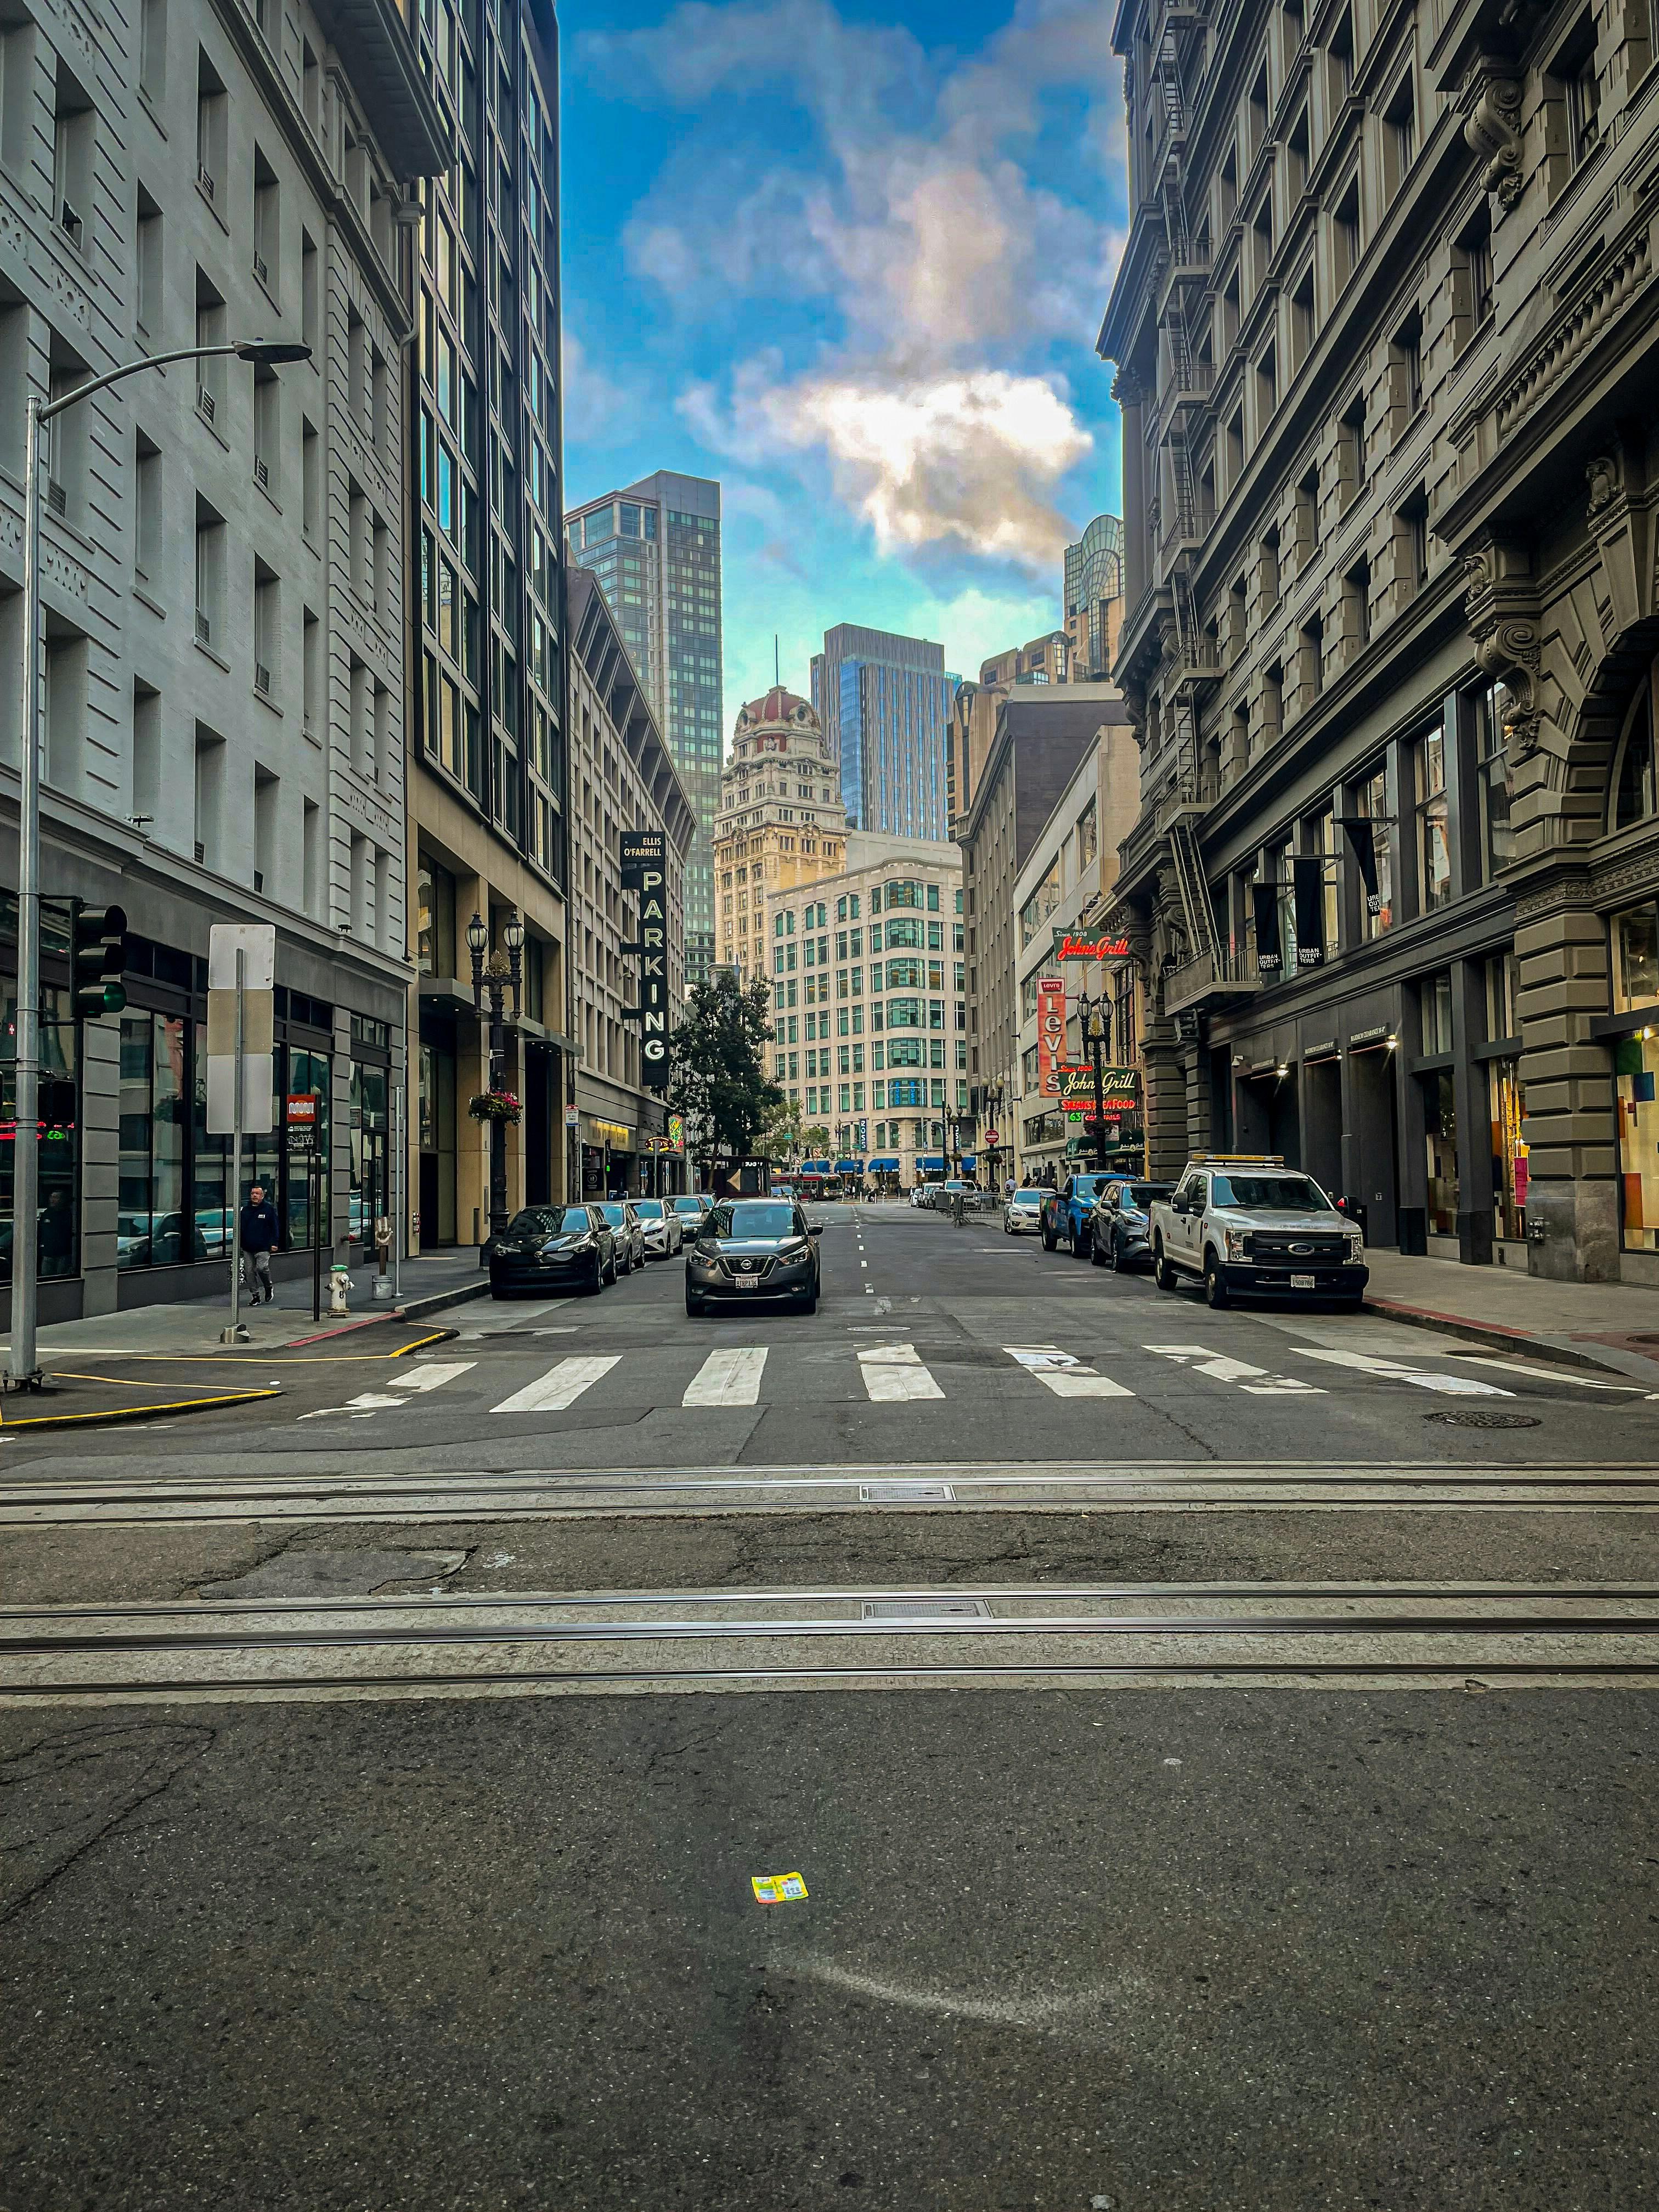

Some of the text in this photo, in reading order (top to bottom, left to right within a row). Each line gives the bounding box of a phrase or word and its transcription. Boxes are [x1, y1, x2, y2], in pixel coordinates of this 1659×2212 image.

[642, 837, 662, 845] ELLIS
[624, 848, 662, 856] O'FARRELL
[1057, 936, 1128, 960] John's Grill
[643, 872, 664, 1059] PARKING
[1063, 1071, 1135, 1096] John Grill
[1102, 1099, 1136, 1109] EAFOOD
[1070, 1112, 1081, 1121] 63
